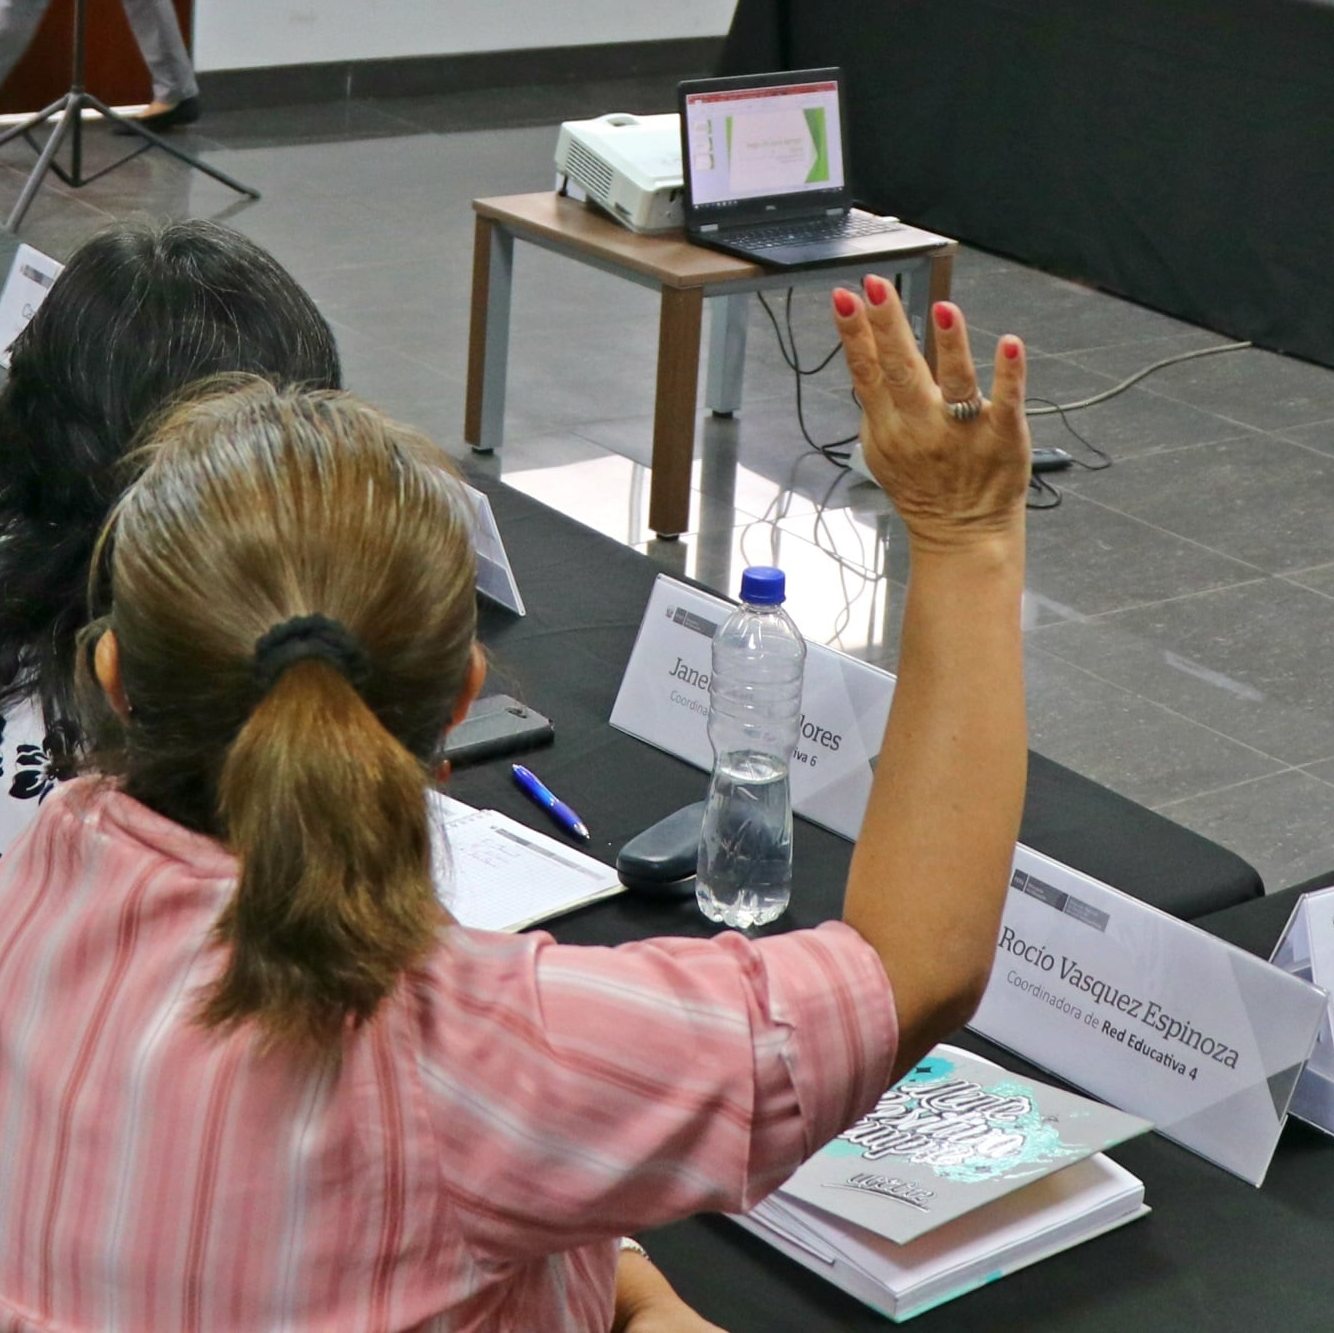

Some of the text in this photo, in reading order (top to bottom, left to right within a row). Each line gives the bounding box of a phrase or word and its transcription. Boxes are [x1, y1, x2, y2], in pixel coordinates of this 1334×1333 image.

[670, 690, 708, 716] Coordina
[809, 755, 817, 767] 6
[799, 715, 841, 751] lores
[998, 926, 1239, 1069] Rocío Vasquez Espinoza
[1007, 969, 1198, 1081] Coordinadora de Red Educativa 4
